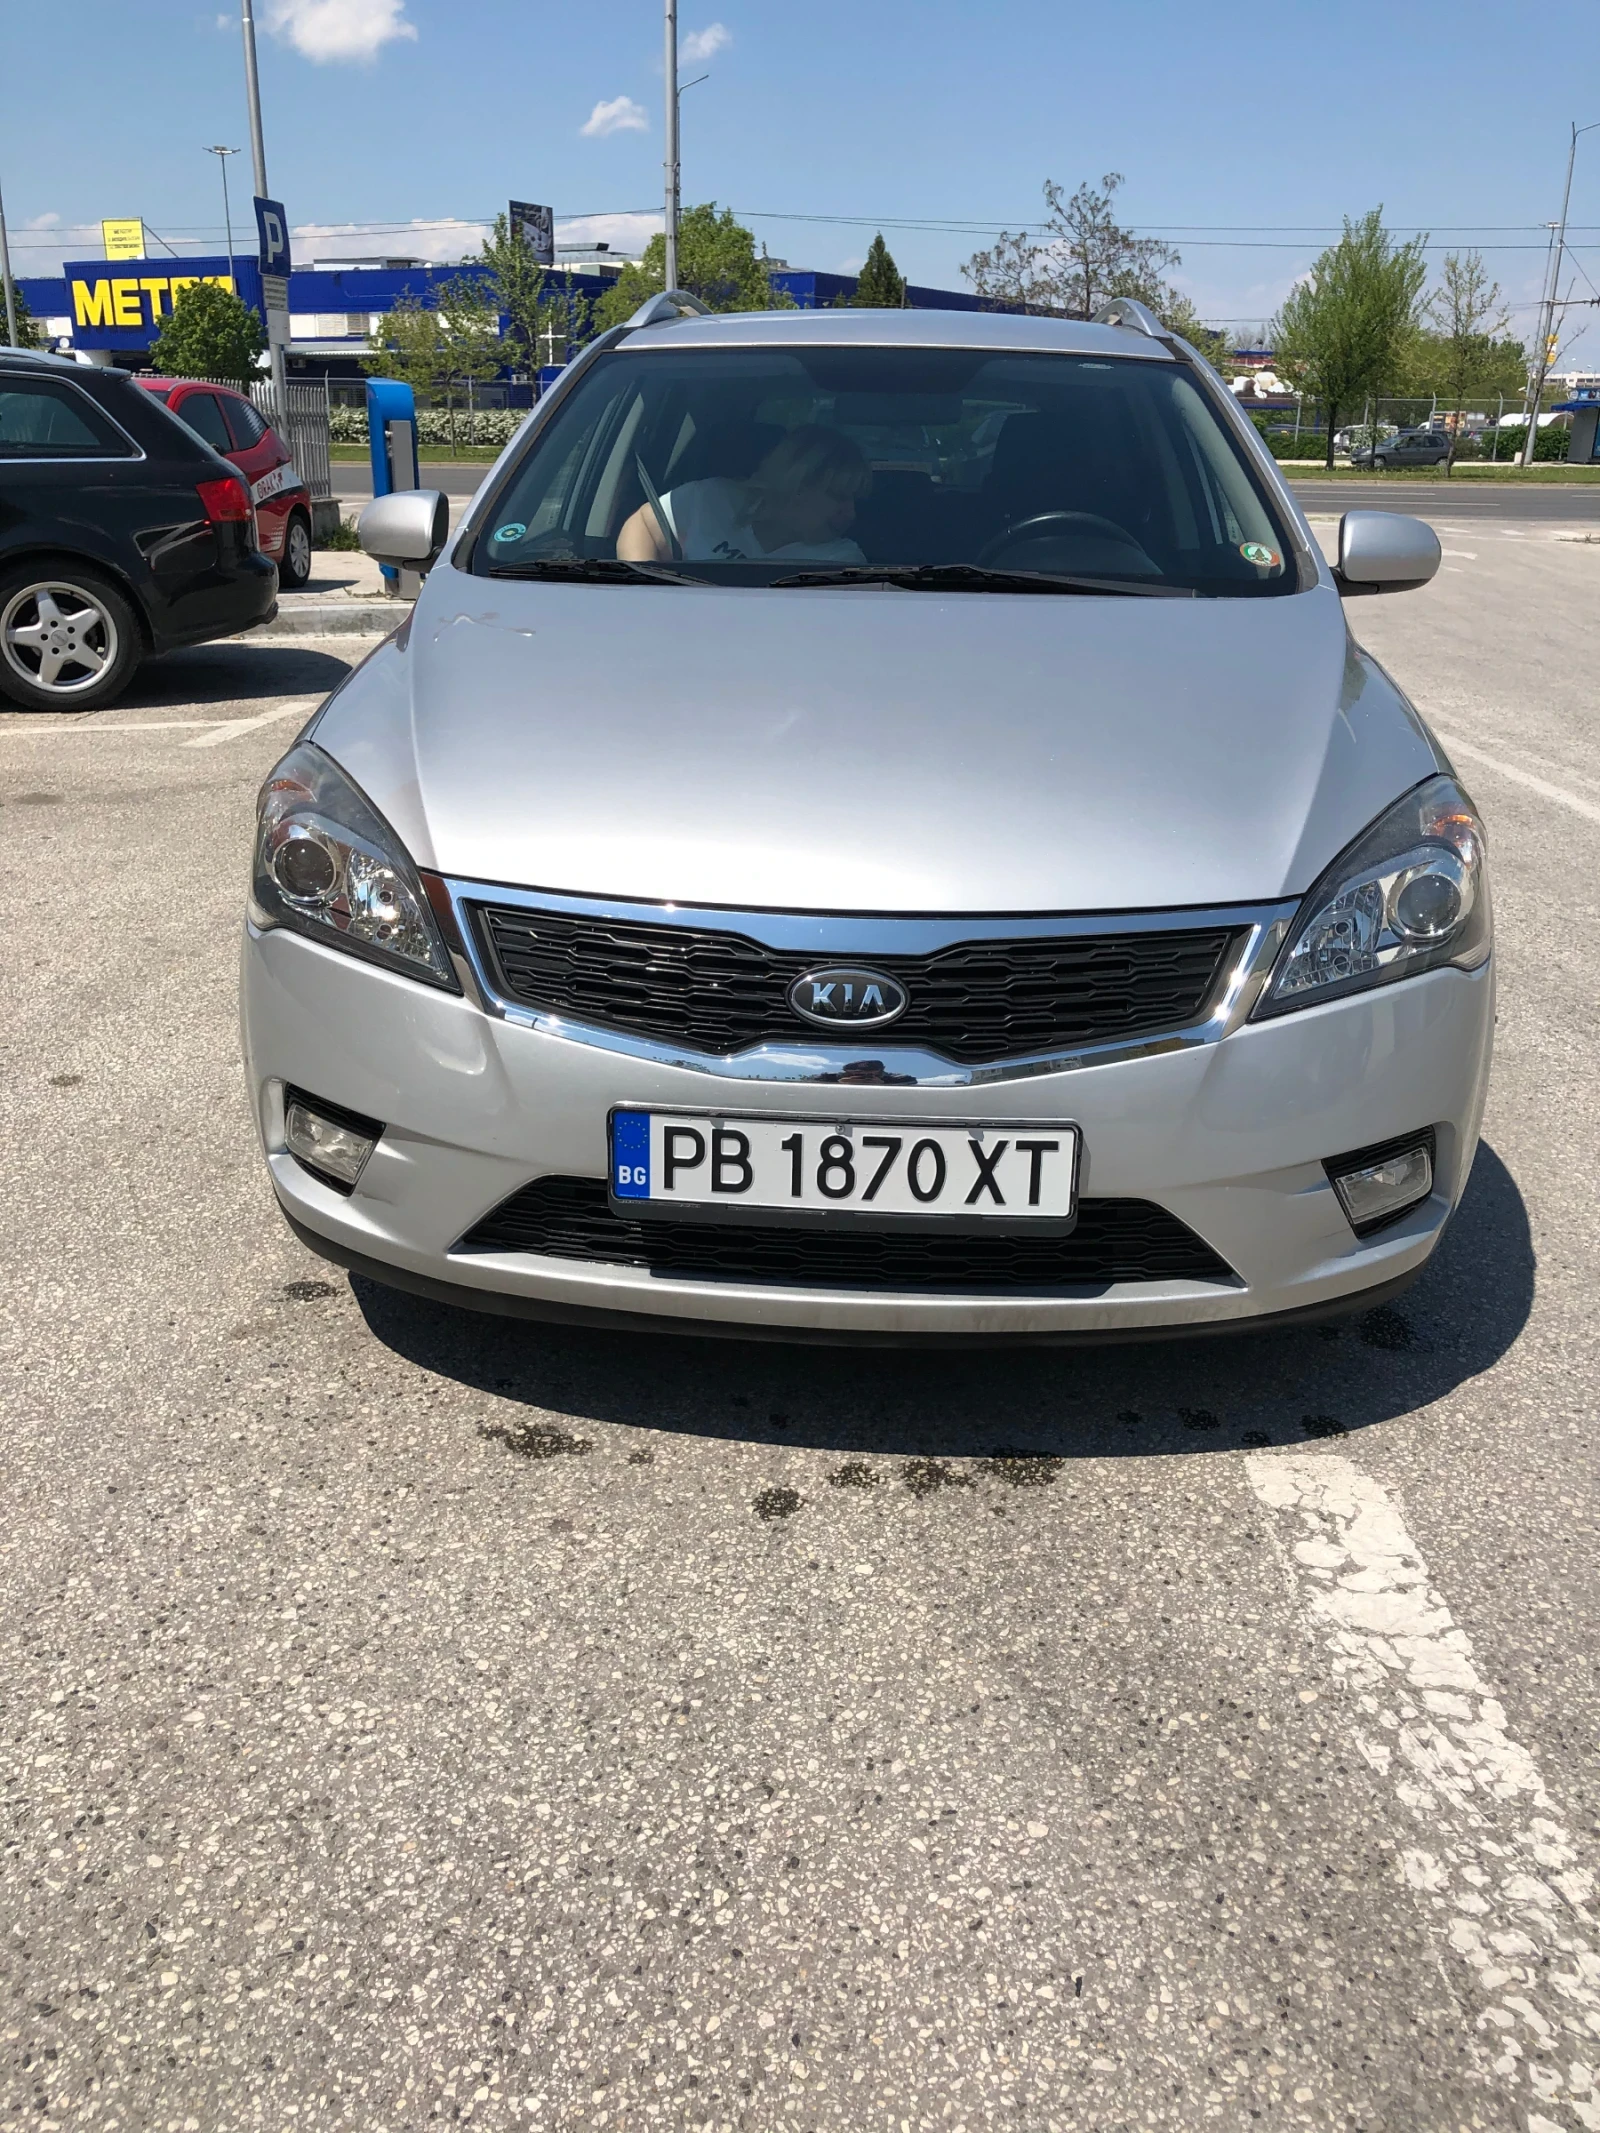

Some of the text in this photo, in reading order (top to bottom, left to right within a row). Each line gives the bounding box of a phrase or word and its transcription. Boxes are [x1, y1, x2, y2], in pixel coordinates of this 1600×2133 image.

[263, 211, 284, 264] P
[72, 276, 234, 326] MET
[810, 982, 887, 1014] KIA
[618, 1165, 646, 1185] BG
[663, 1125, 1060, 1206] PB 1870 XT
